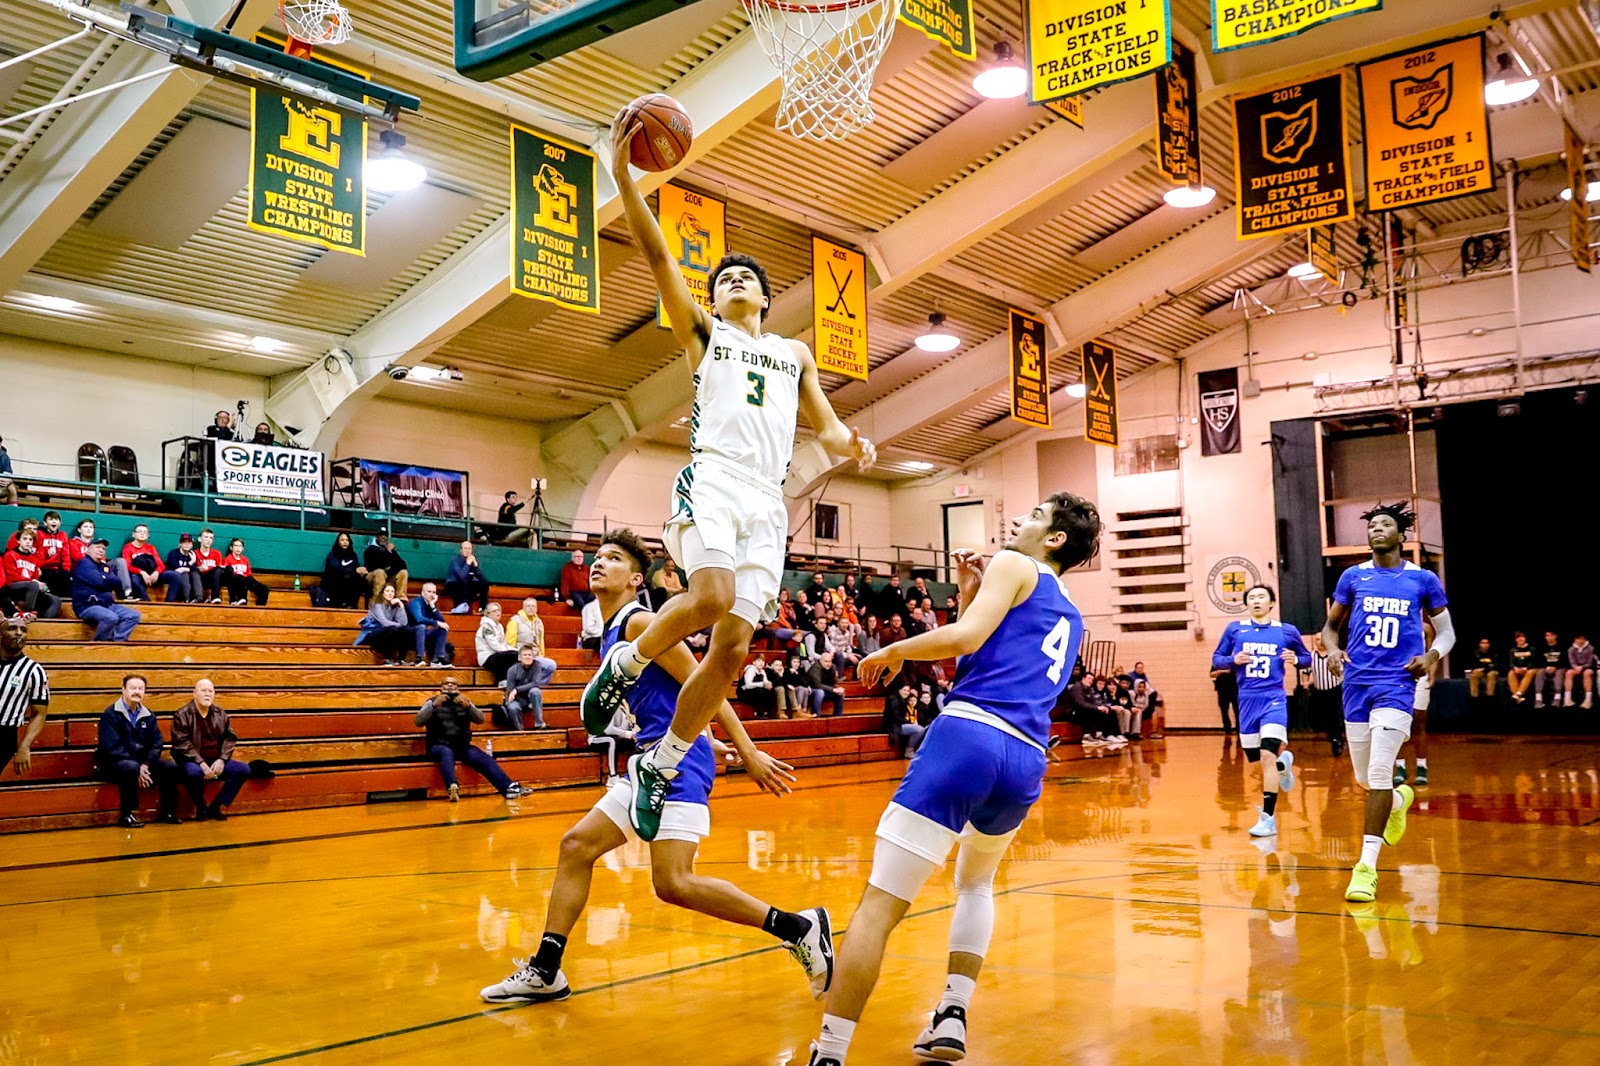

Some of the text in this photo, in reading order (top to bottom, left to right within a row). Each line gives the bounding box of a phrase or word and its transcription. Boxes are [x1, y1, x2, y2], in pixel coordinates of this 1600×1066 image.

[905, 0, 963, 46] CHAMPIONS
[1045, 1, 1127, 38] DIVISION
[1067, 22, 1127, 51] STATE
[1037, 29, 1159, 77] TRACK FIELD
[1404, 51, 1436, 69] 2012
[1047, 50, 1152, 92] CHAMPIONS
[1272, 86, 1302, 104] 2012
[543, 143, 566, 162] 2007
[1381, 135, 1455, 161] DIVISION
[266, 153, 334, 187] DIVISION
[1399, 152, 1455, 173] STATE
[1251, 165, 1319, 190] DIVISION
[1373, 173, 1422, 192] TRACK
[1439, 160, 1485, 179] FIELD
[285, 179, 334, 206] STATE
[684, 192, 703, 207] 2006
[1243, 200, 1291, 218] TRACK
[1300, 188, 1345, 208] FIELD
[1267, 181, 1318, 201] STATE
[1382, 176, 1477, 204] CHAMPIONS
[264, 190, 353, 227] WRESTLING
[1251, 203, 1338, 230] CHAMPIONS
[264, 208, 353, 244] CHAMPIONS
[523, 227, 574, 255] DIVISION
[537, 248, 574, 271] STATE
[523, 259, 588, 288] WRESTLING
[523, 274, 589, 303] CHAMPIONS
[821, 318, 854, 336] DIVISION
[828, 345, 857, 361] HOCKEY
[830, 333, 853, 349] STATE
[714, 346, 797, 378] ST. EDWARD
[822, 354, 864, 374] CHAMPIONS
[746, 371, 765, 407] 3
[1210, 407, 1229, 421] HS
[252, 449, 318, 474] EAGLES
[223, 470, 317, 490] SPORTS NETWORK
[390, 486, 424, 498] Cleveland
[1363, 596, 1411, 616] SPIRE
[1364, 615, 1400, 648] 30
[1040, 615, 1071, 685] 4
[1242, 642, 1278, 656] SPIRE
[1245, 655, 1271, 679] 23
